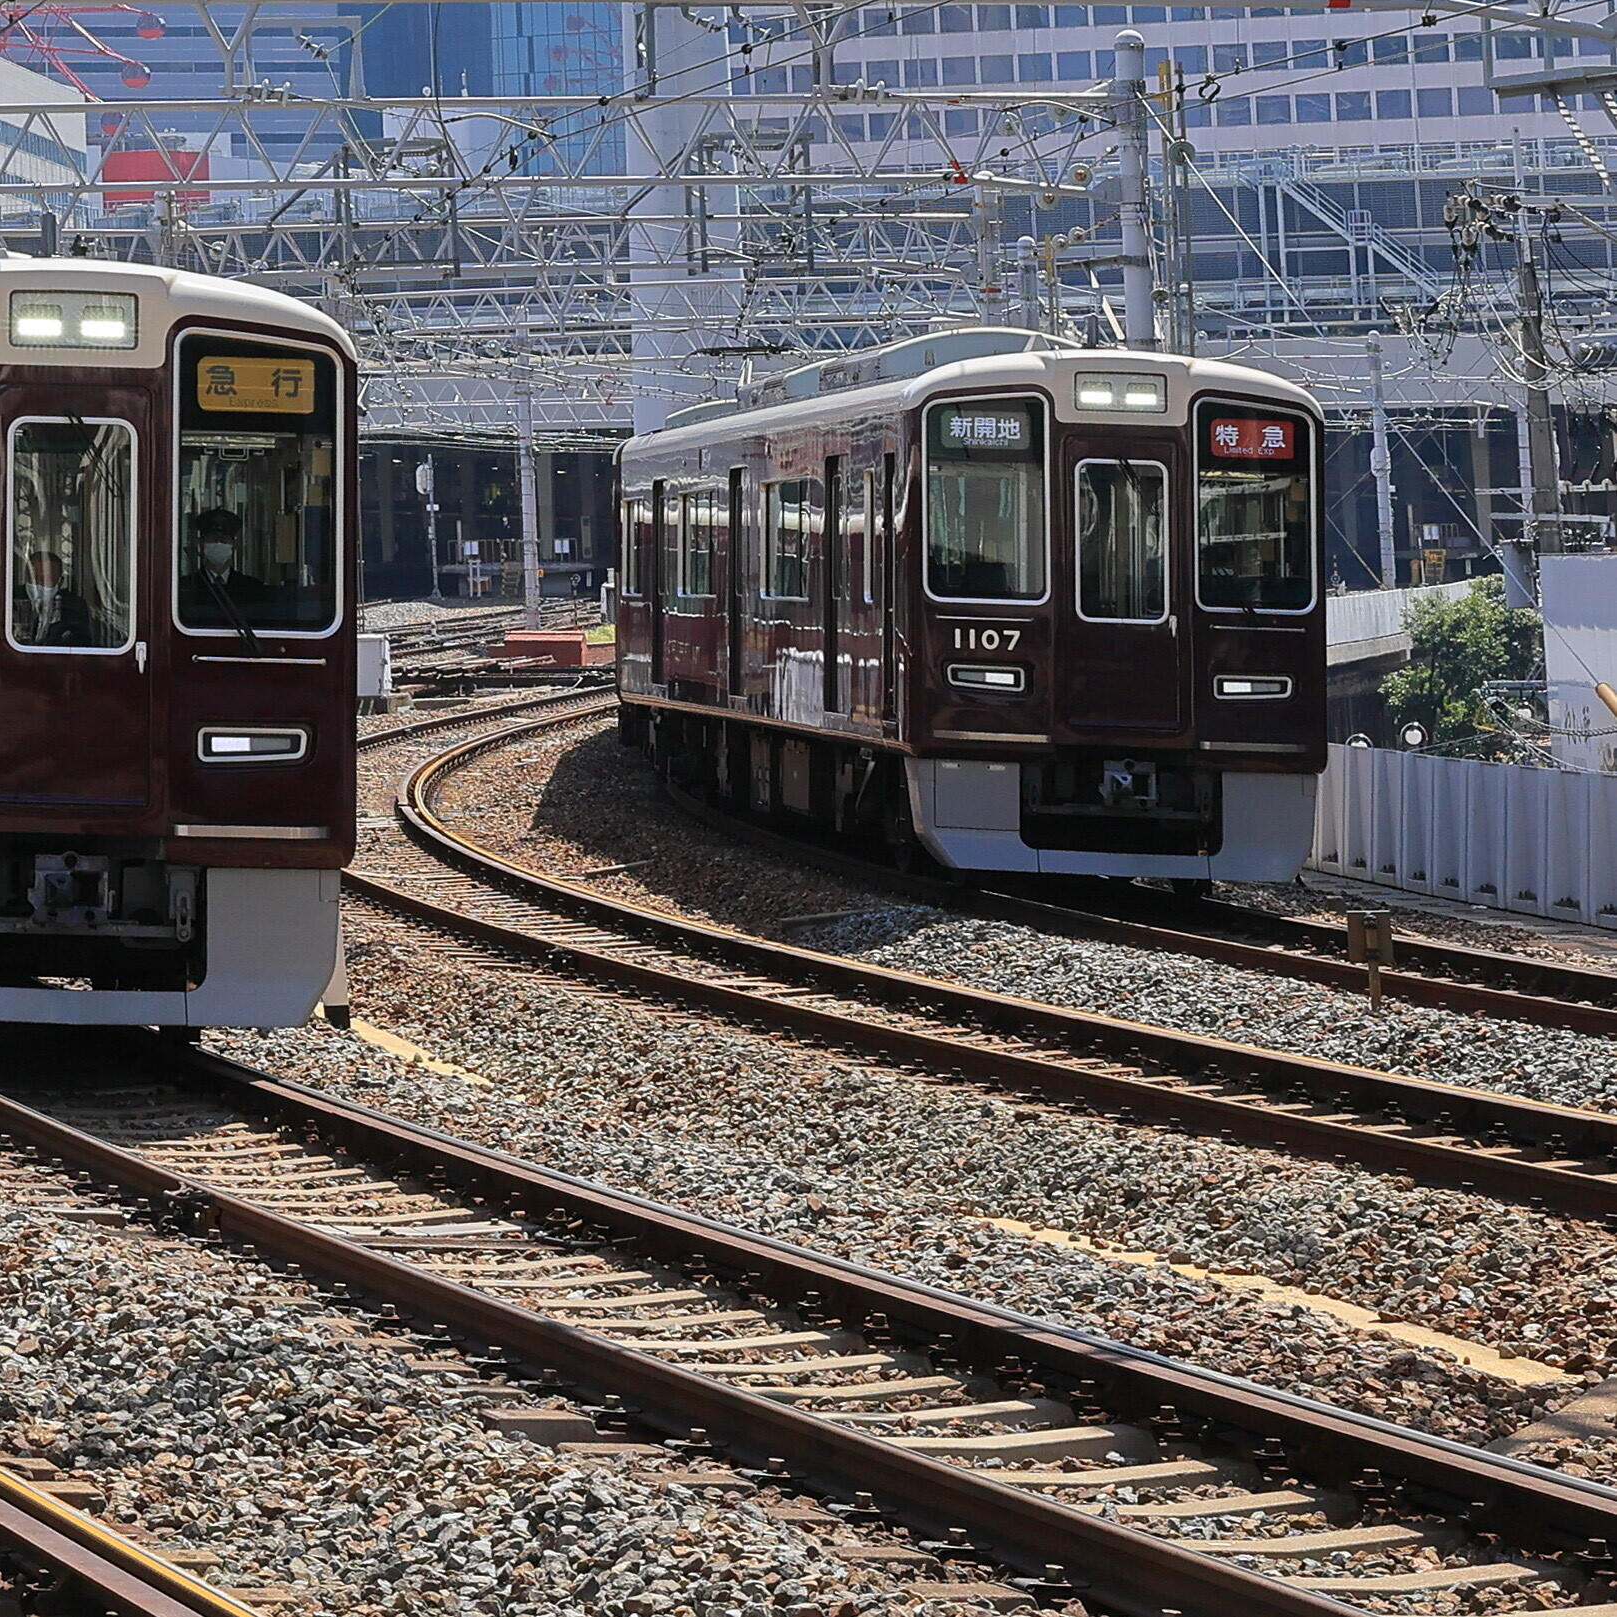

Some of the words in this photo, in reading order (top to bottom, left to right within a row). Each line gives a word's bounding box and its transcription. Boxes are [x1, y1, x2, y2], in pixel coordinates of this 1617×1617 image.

[206, 365, 302, 397] 急行
[229, 396, 279, 408] Express
[950, 416, 1021, 440] 新開地
[1215, 425, 1286, 448] 特急
[1224, 446, 1254, 455] Limited
[954, 628, 1021, 651] 1107
